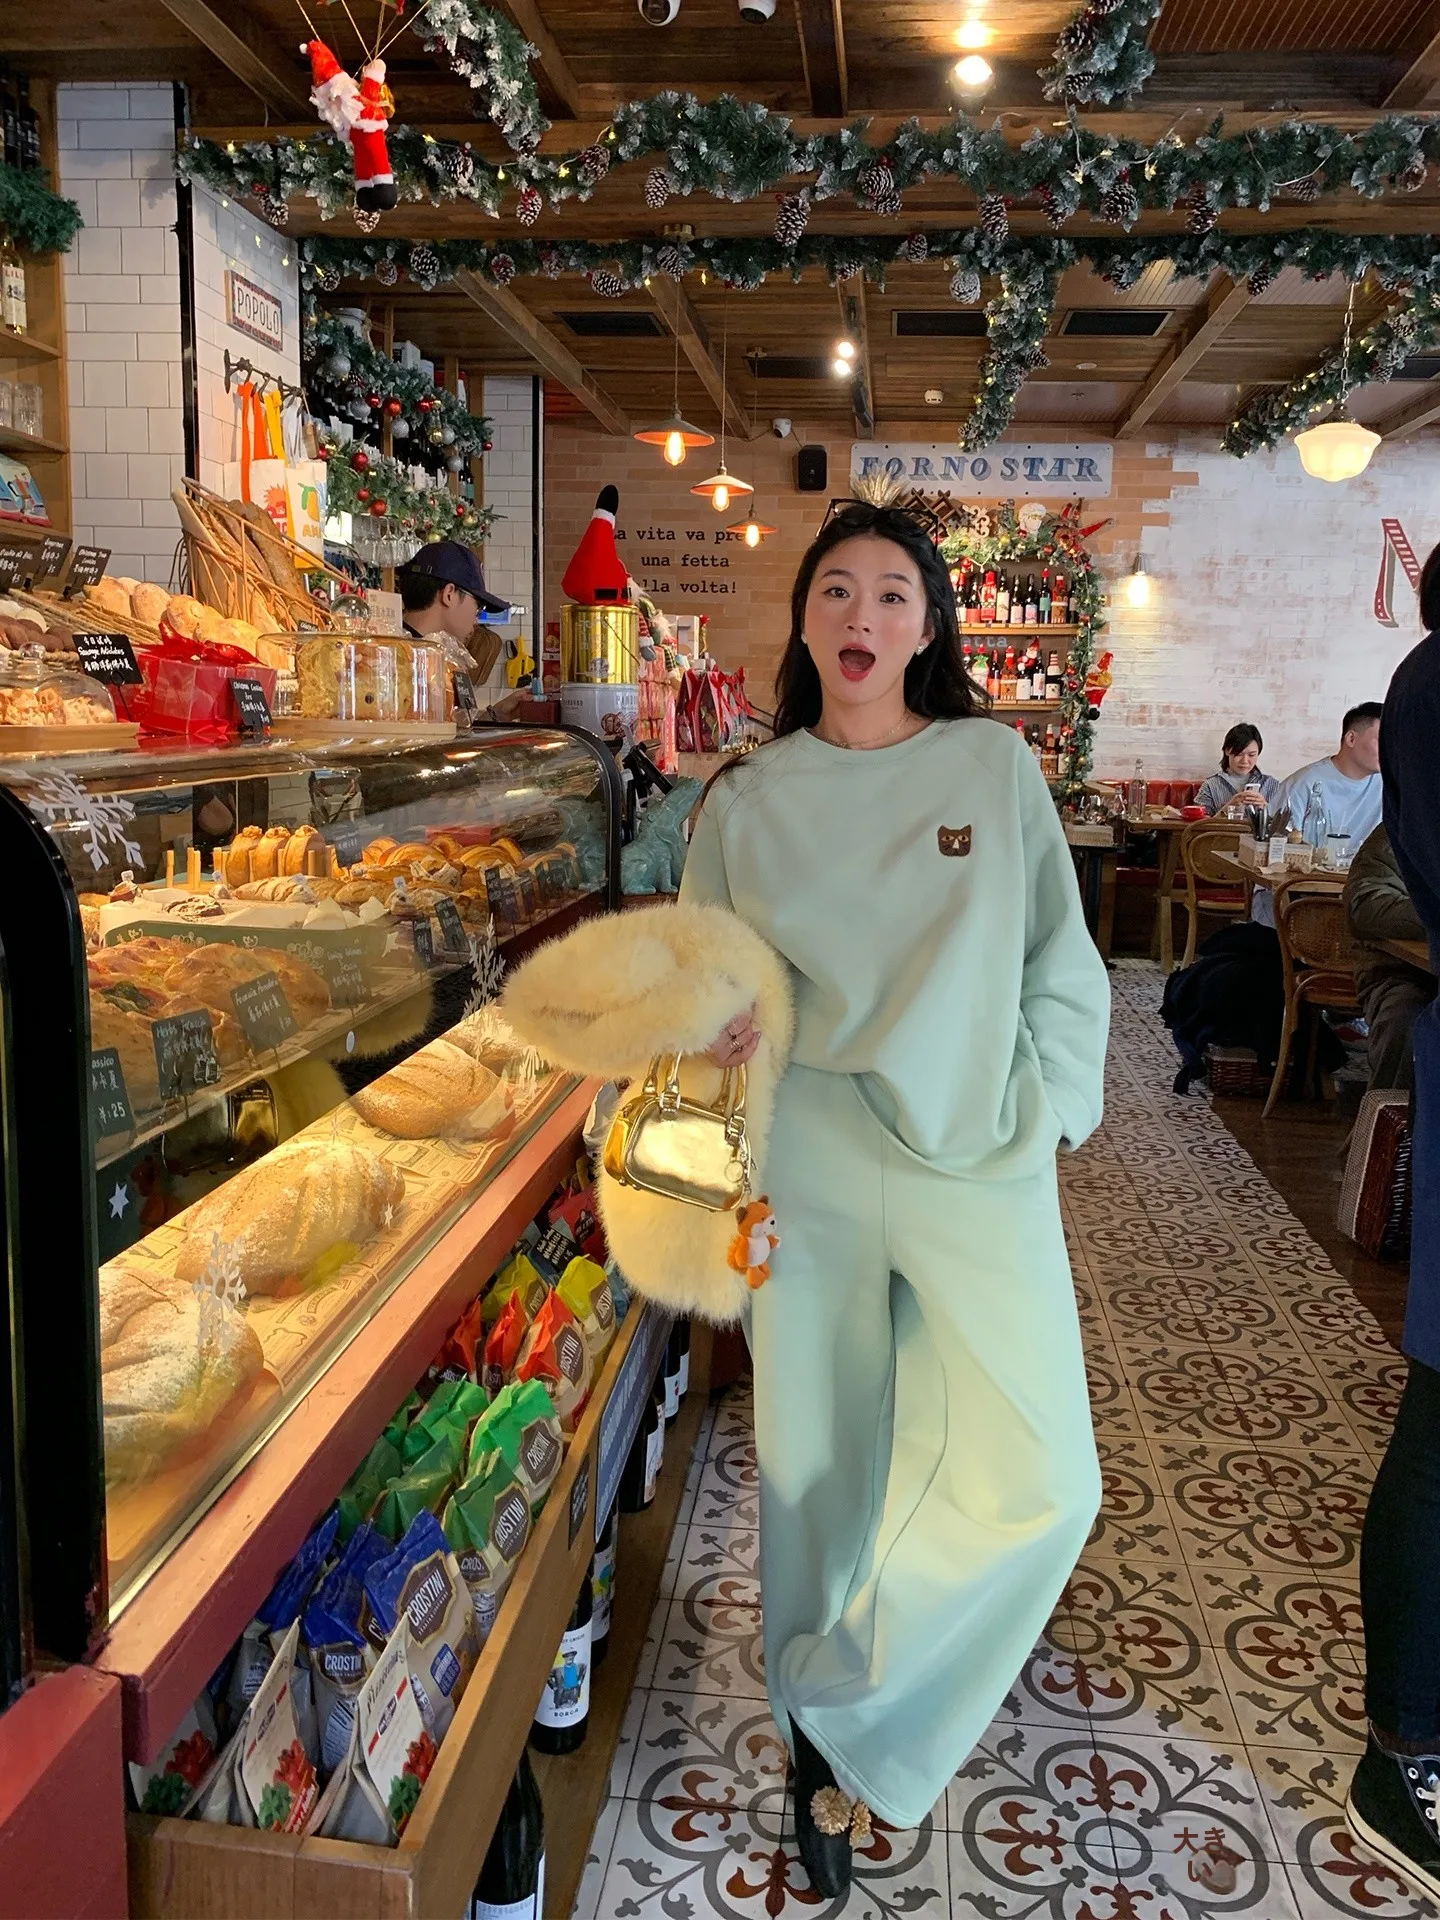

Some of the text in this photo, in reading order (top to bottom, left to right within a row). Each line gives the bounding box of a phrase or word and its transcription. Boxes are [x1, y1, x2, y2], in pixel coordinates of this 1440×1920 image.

[237, 286, 280, 335] POPOLO
[858, 456, 1103, 482] FORNO STAR
[636, 526, 676, 541] vita
[685, 530, 706, 541] va
[640, 554, 730, 568] una fetta
[638, 579, 737, 594] lla volta!
[526, 1430, 552, 1470] CROSTINI
[494, 1497, 527, 1548] CROSTINI
[407, 1568, 446, 1628] CROSTINI
